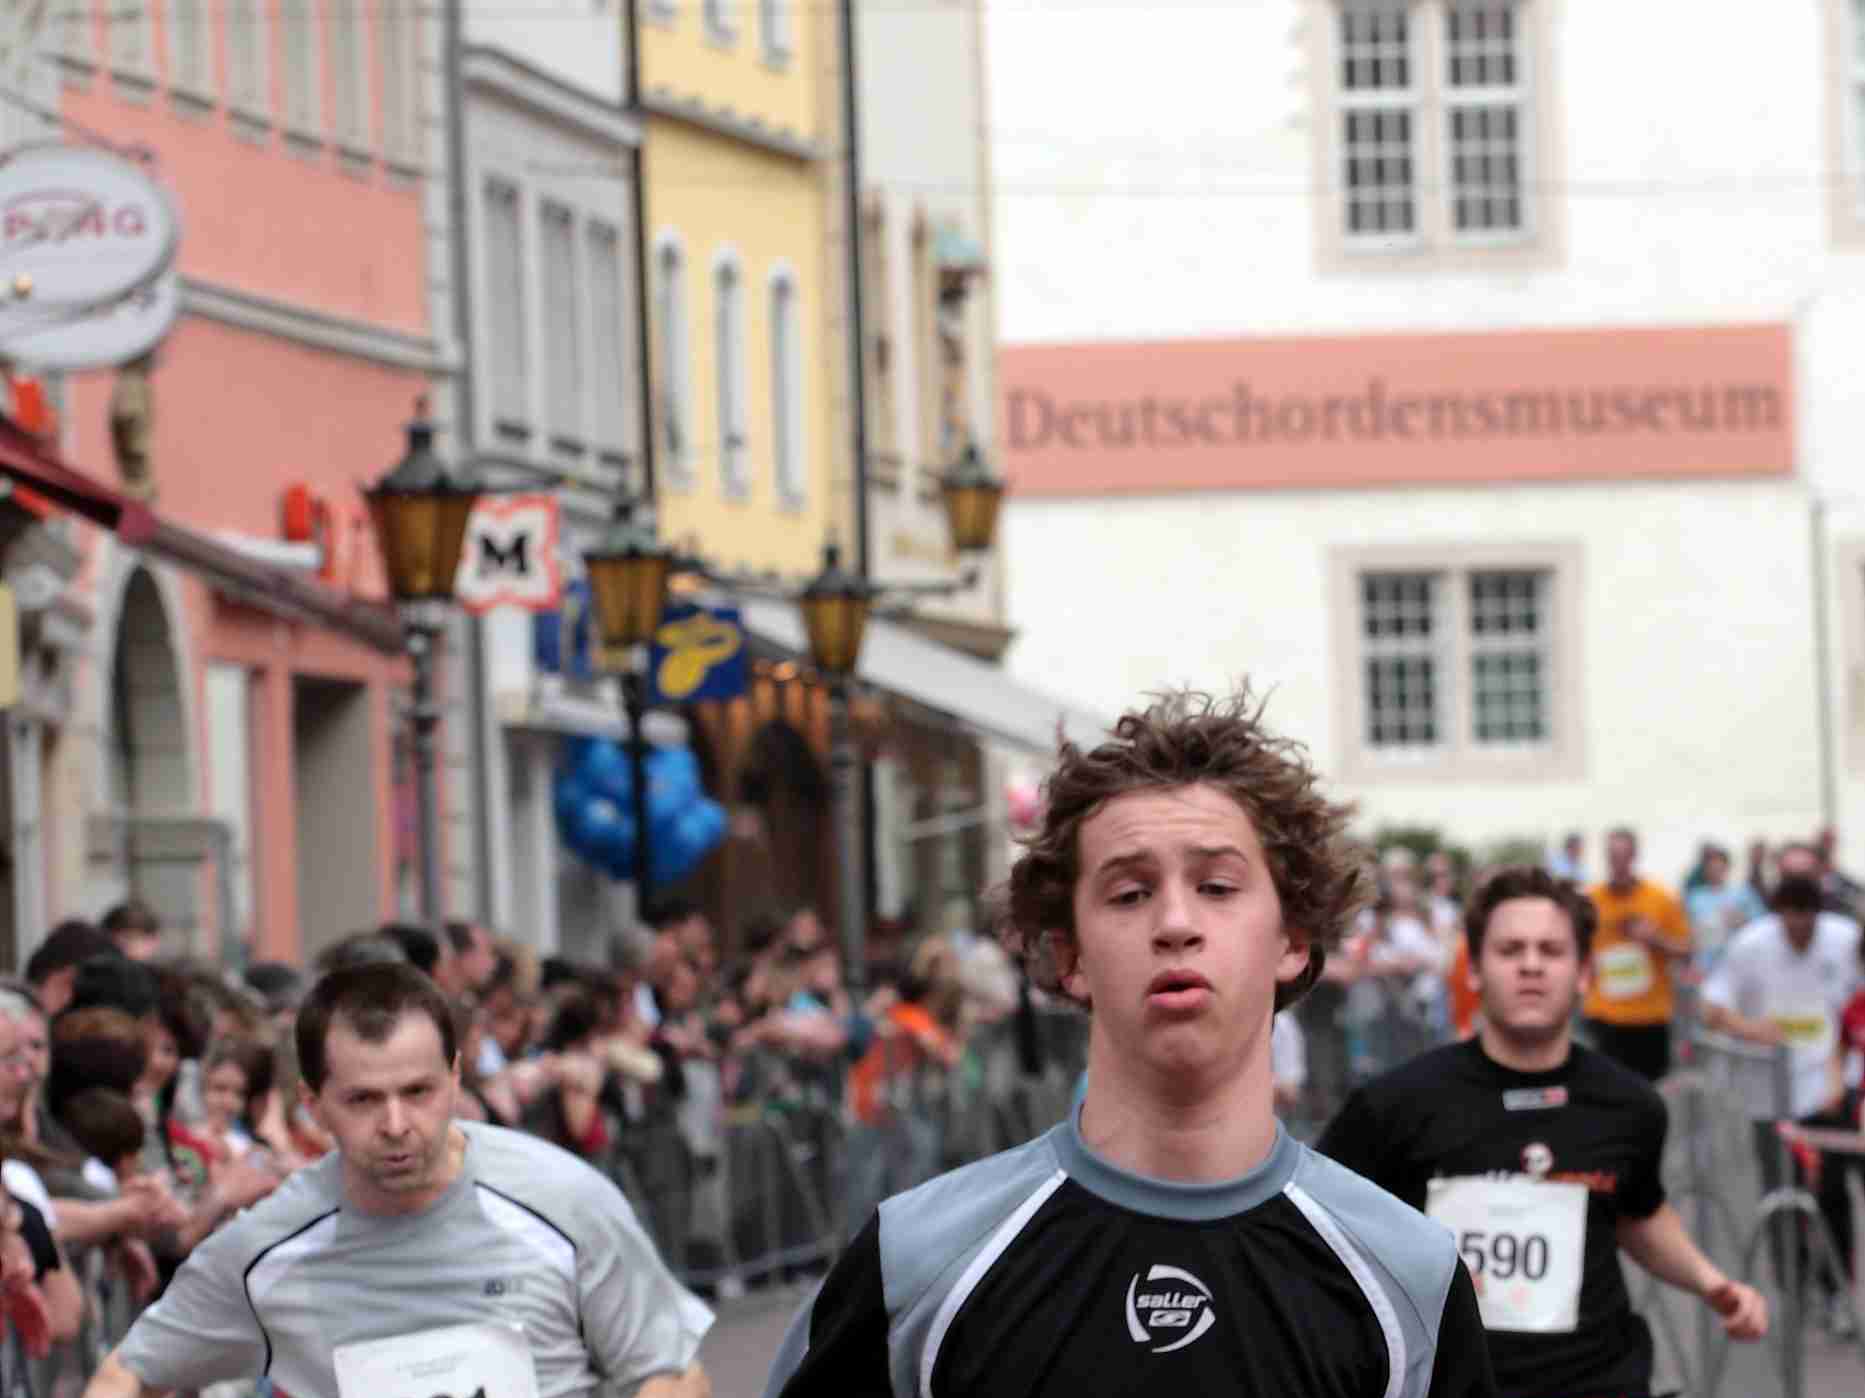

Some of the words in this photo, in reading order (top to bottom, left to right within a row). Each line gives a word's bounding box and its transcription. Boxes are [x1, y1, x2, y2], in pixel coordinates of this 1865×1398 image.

[1004, 375, 1783, 450] Deutschordensmuseum
[480, 531, 528, 576] M
[1460, 1231, 1549, 1282] 590
